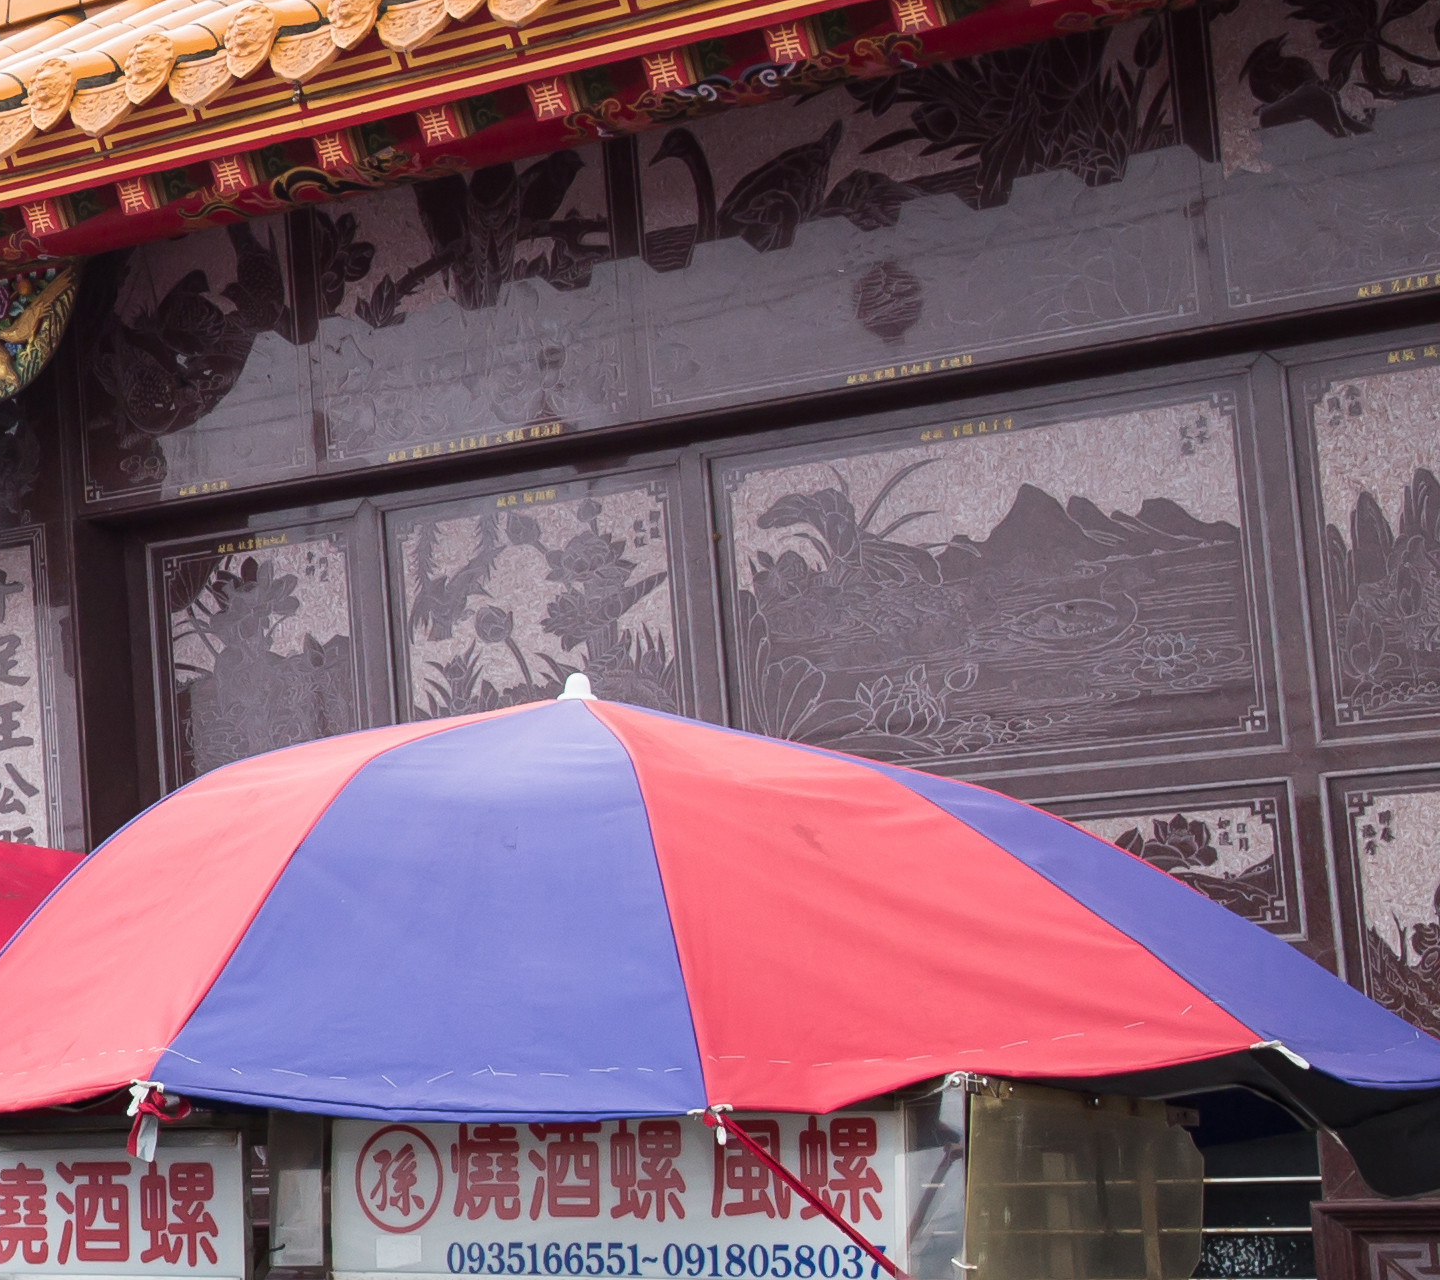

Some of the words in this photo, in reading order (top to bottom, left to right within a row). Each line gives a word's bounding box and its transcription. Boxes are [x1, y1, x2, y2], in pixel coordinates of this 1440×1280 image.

[364, 1134, 433, 1223] 孫
[450, 1120, 686, 1222] 燒酒螺
[710, 1115, 884, 1223] 風螺
